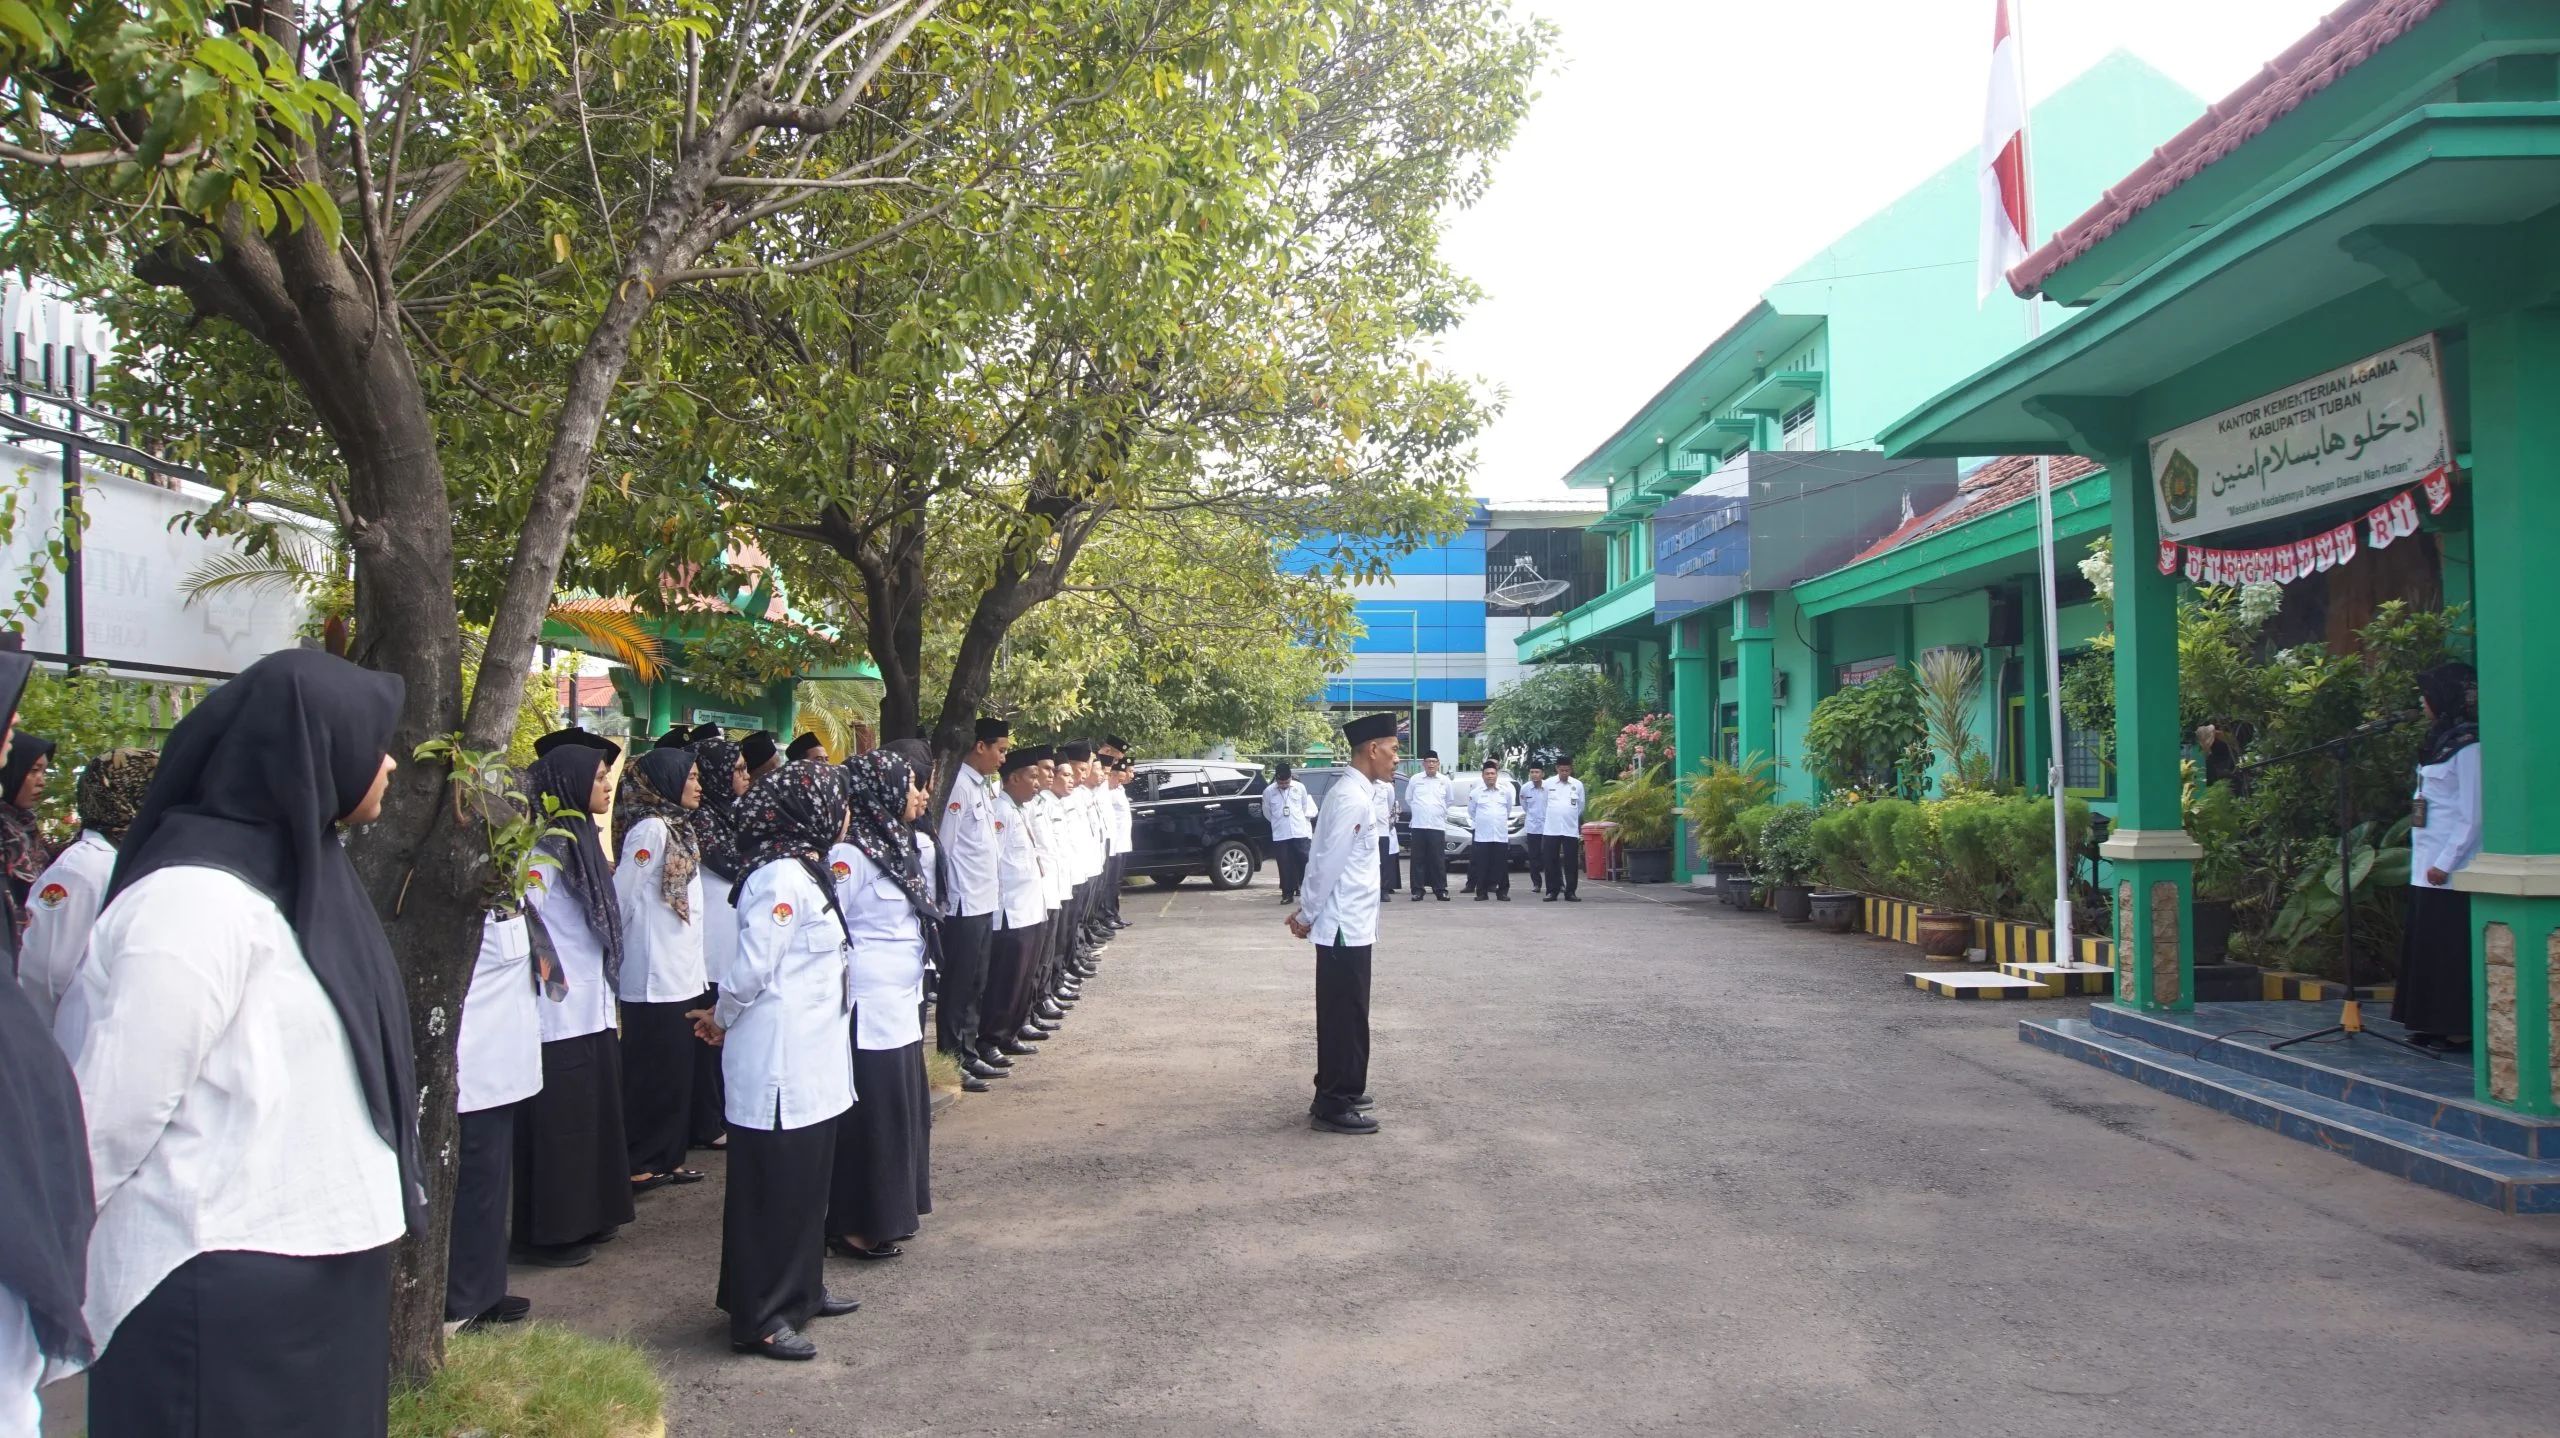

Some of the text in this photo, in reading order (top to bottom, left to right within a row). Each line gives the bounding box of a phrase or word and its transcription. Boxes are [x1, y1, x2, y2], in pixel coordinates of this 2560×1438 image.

[2218, 359, 2399, 434] KANTOR KEMENTERIAN AGAMA
[2249, 391, 2362, 440] KABUPATEN TUBAN
[2306, 480, 2335, 499] Dengan
[2337, 473, 2362, 489] Damai
[2364, 468, 2381, 481] Nan
